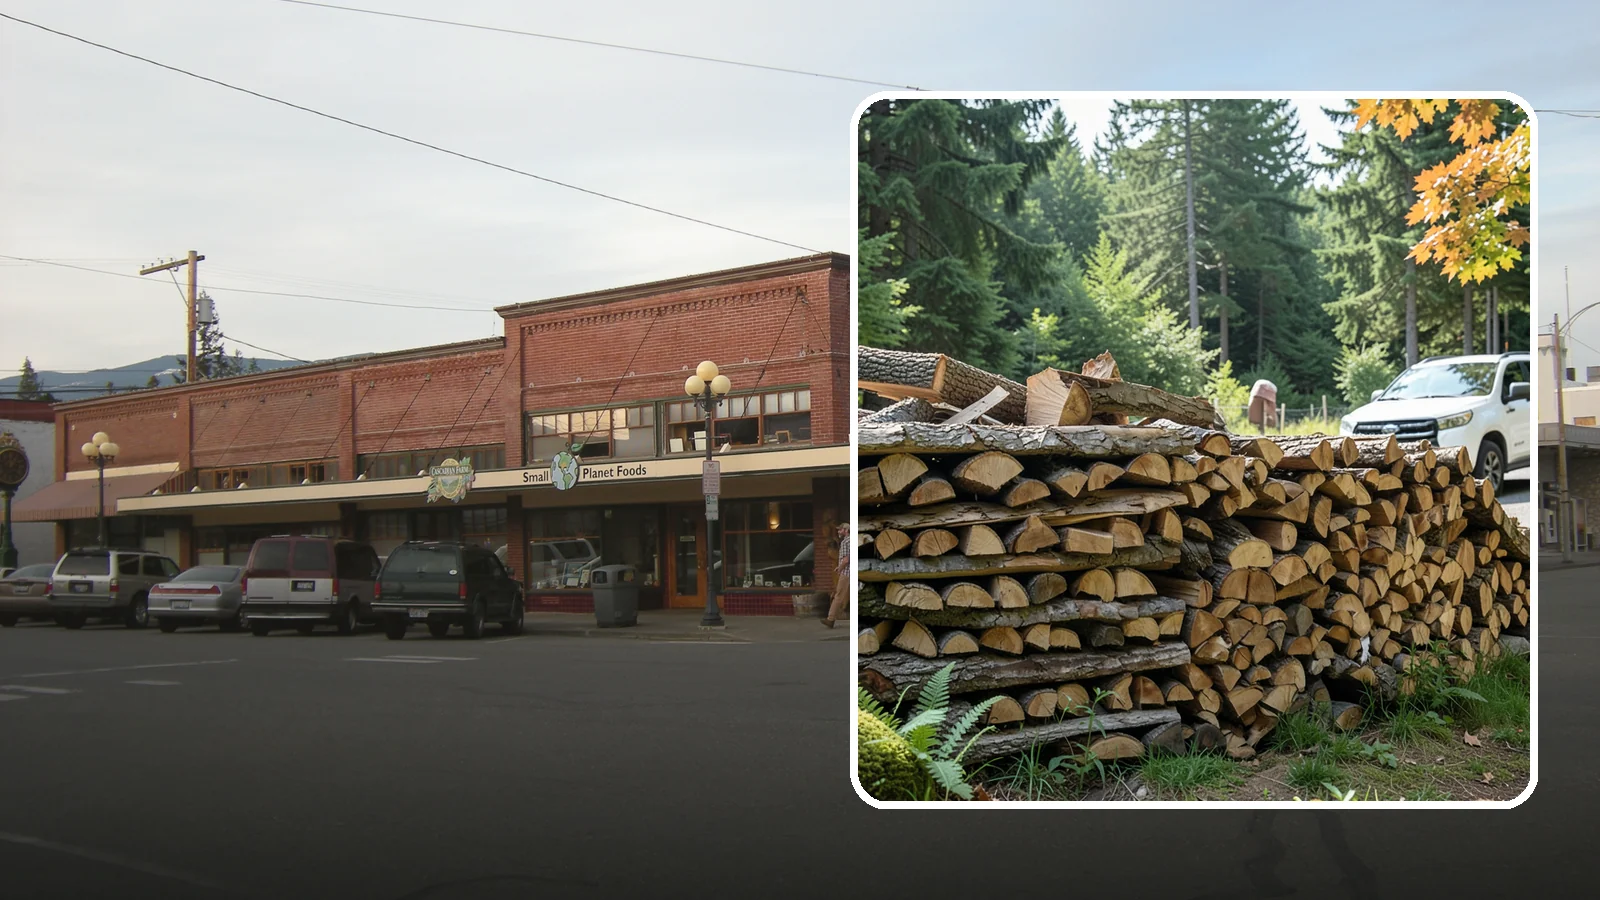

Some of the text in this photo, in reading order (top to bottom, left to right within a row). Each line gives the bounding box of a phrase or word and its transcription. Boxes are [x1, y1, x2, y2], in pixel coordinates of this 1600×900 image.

[523, 464, 647, 483] Small Planet Foods
